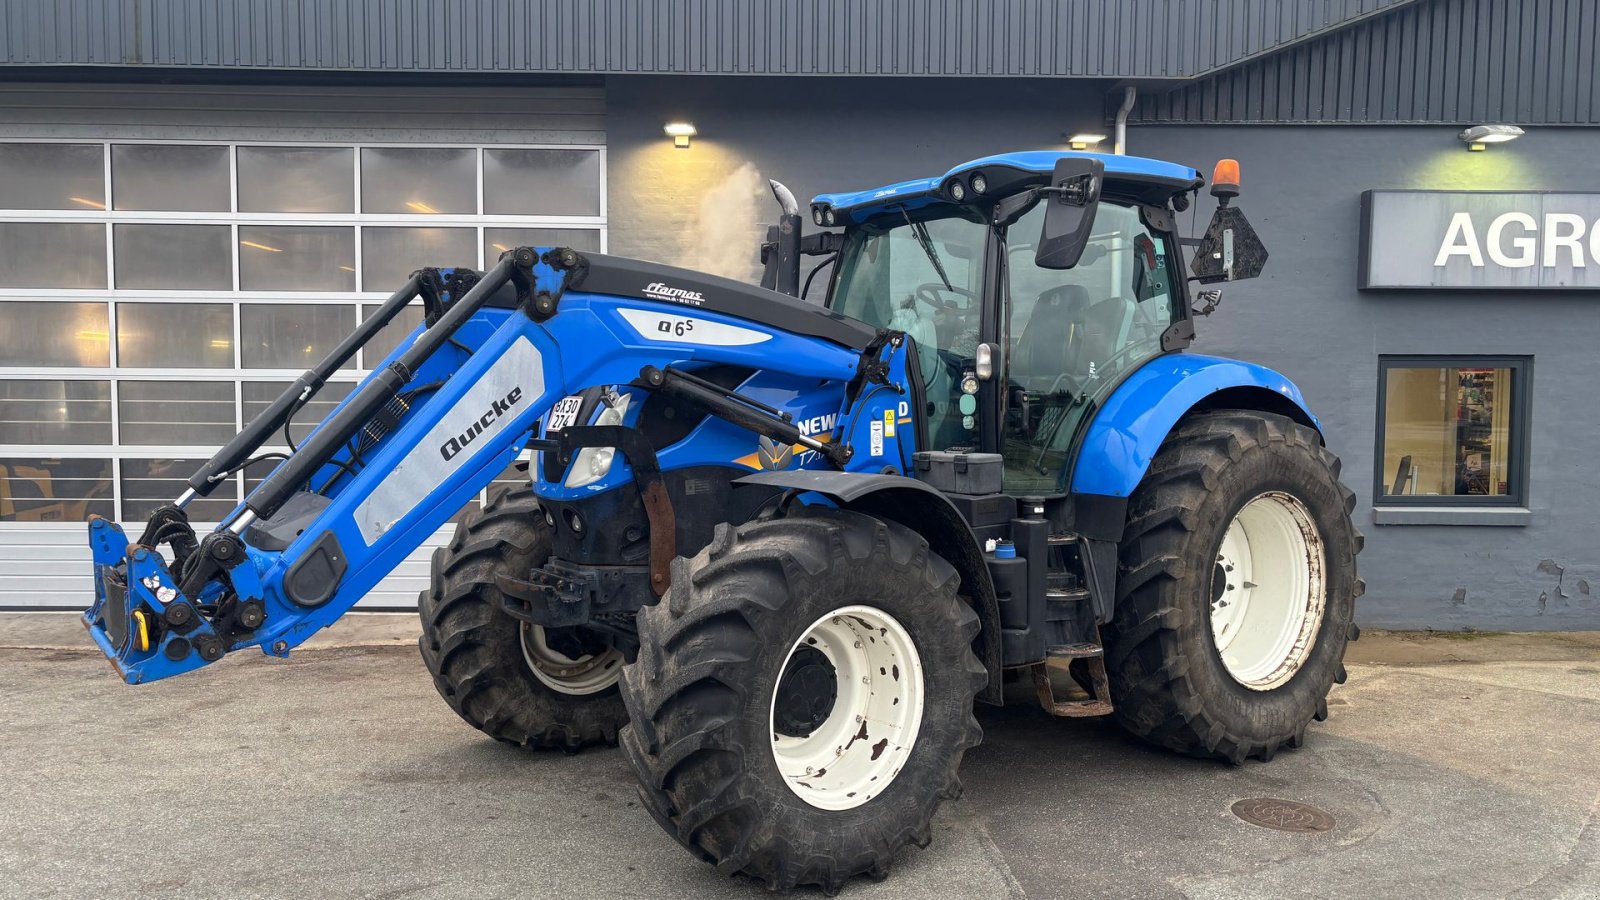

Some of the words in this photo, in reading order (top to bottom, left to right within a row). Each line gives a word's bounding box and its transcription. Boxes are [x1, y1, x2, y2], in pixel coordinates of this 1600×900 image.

[1433, 211, 1600, 268] AGR
[439, 386, 522, 462] Quicke
[797, 412, 837, 436] NEW
